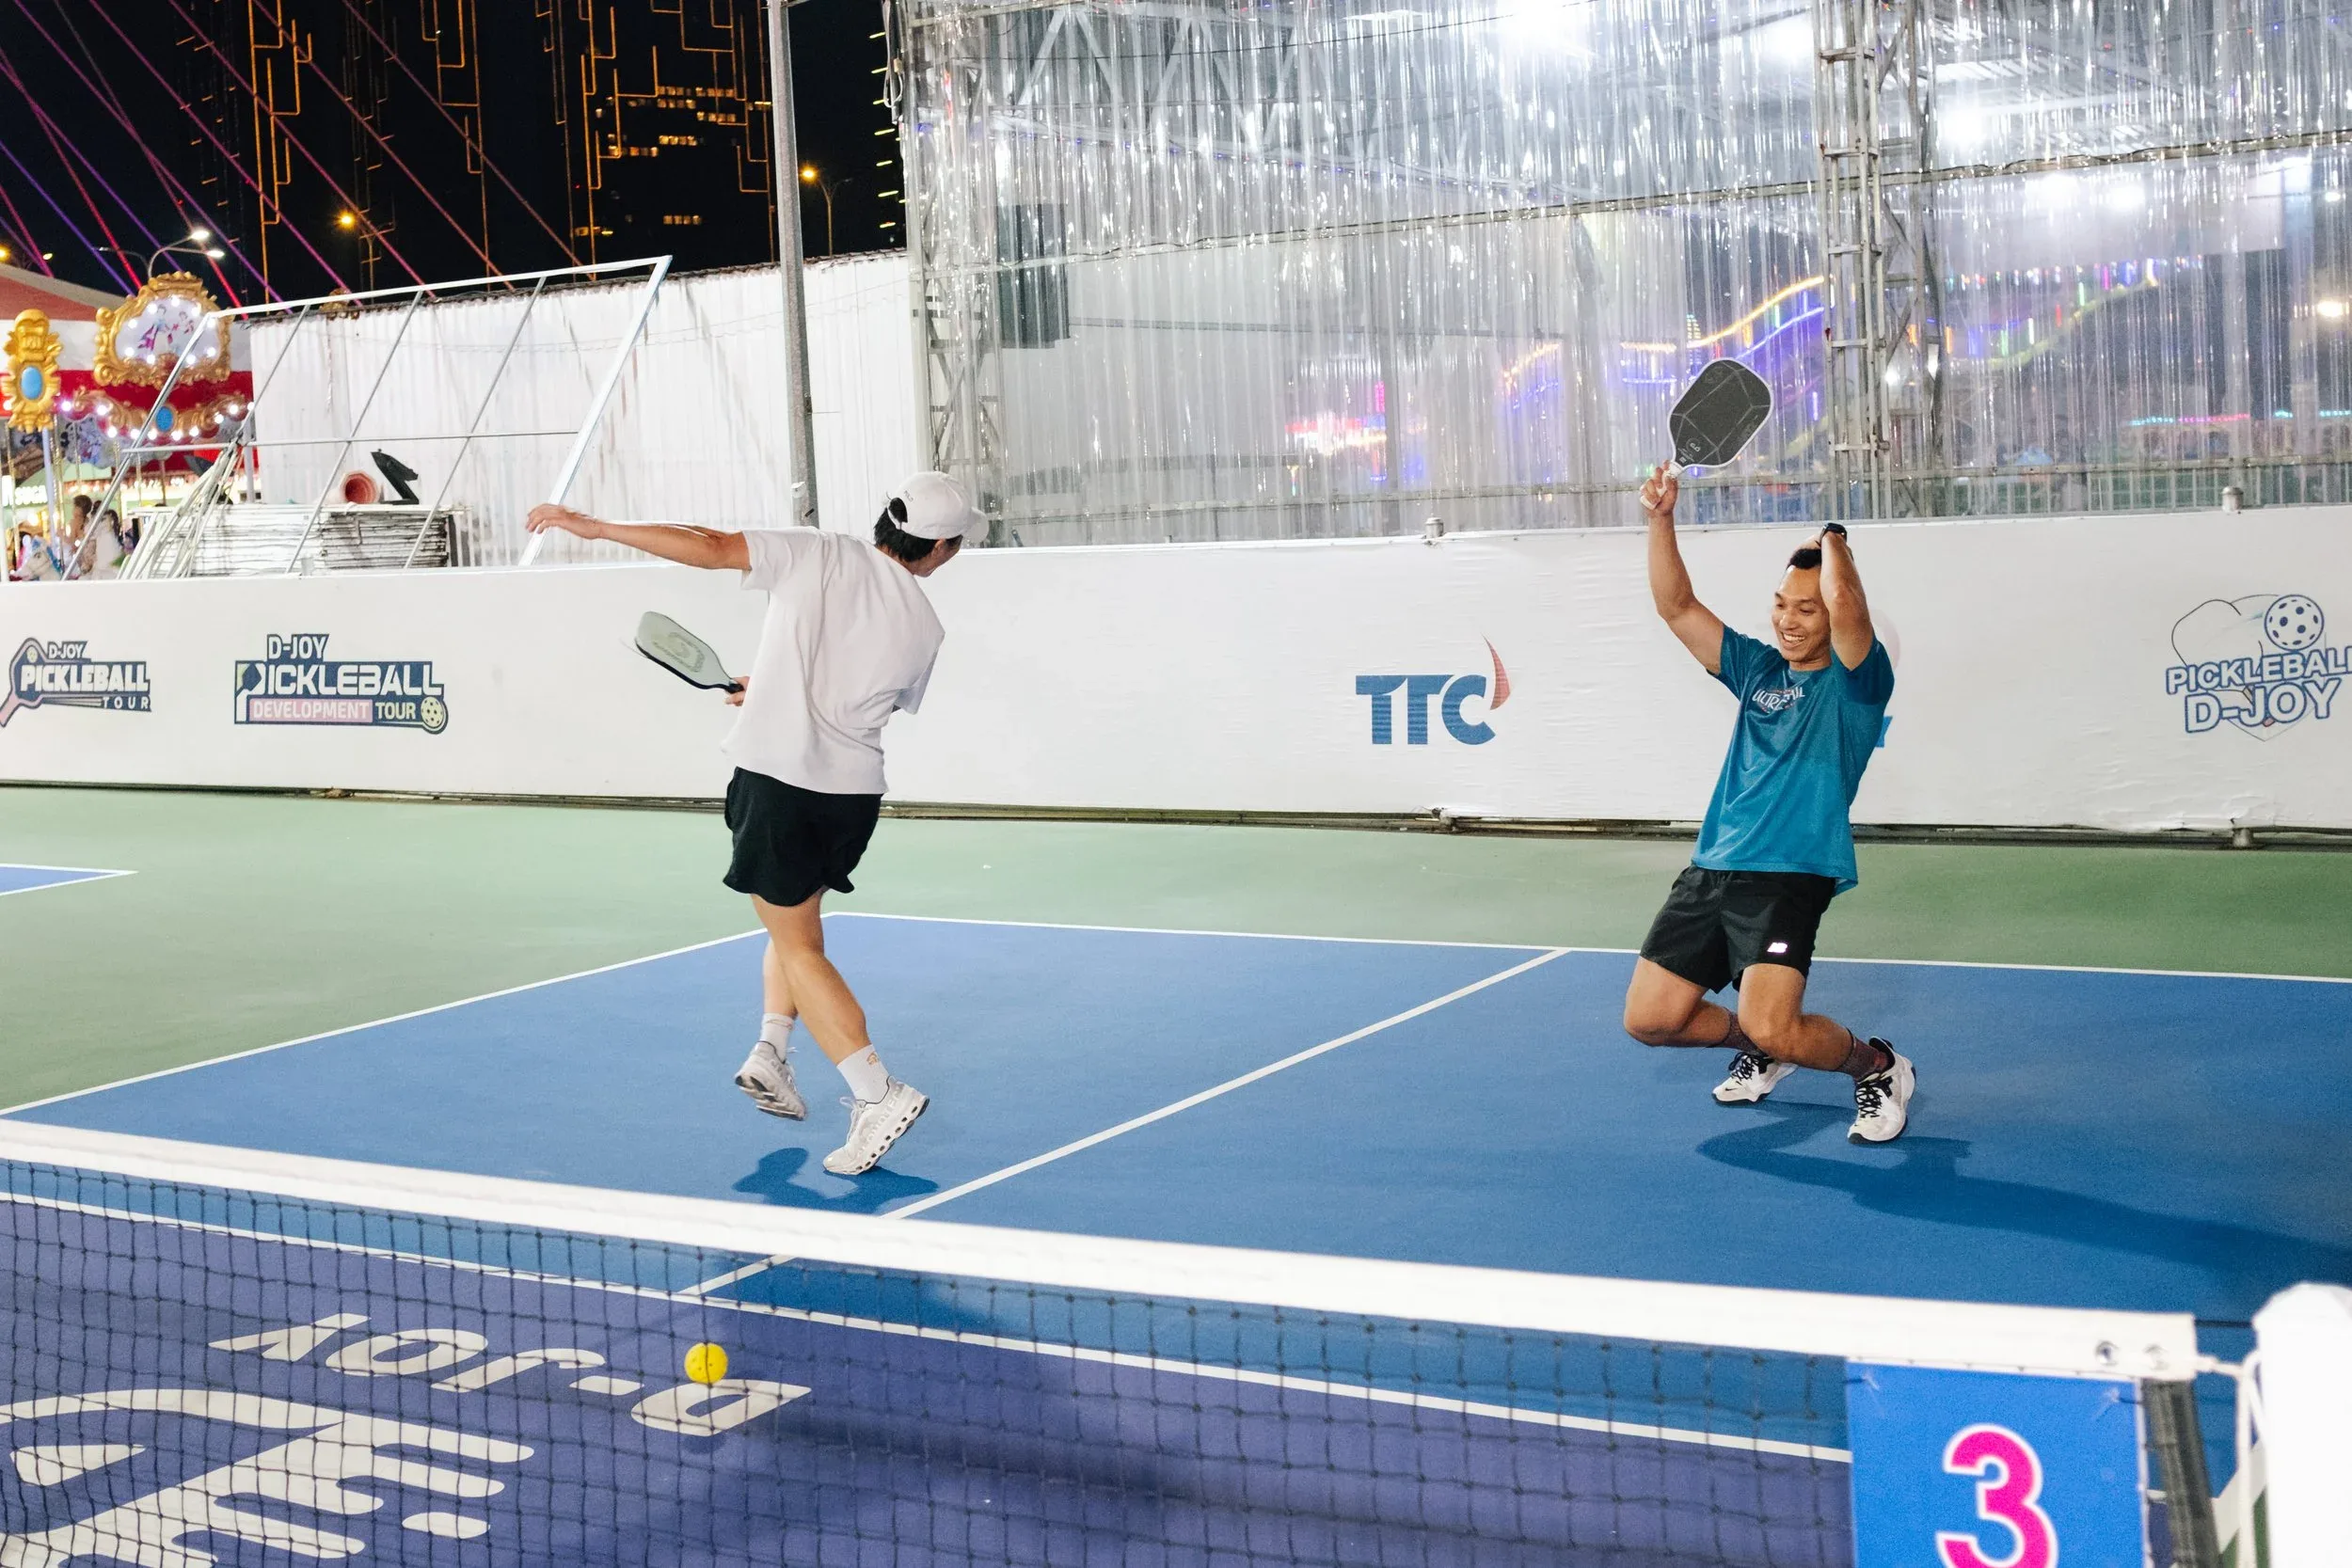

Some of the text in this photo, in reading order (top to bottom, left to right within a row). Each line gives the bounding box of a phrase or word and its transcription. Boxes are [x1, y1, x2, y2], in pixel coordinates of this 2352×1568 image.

[48, 643, 84, 658] D-JOY
[267, 636, 327, 659] D-JOY
[20, 664, 150, 692] PICKLEBALL
[236, 662, 443, 720] PICKLEBALL
[103, 696, 151, 709] TOUR
[252, 701, 416, 720] DEVELOPMENT TOUR
[1355, 673, 1497, 745] TTC
[2184, 677, 2343, 734] D-JOY
[1935, 1423, 2059, 1568] 3
